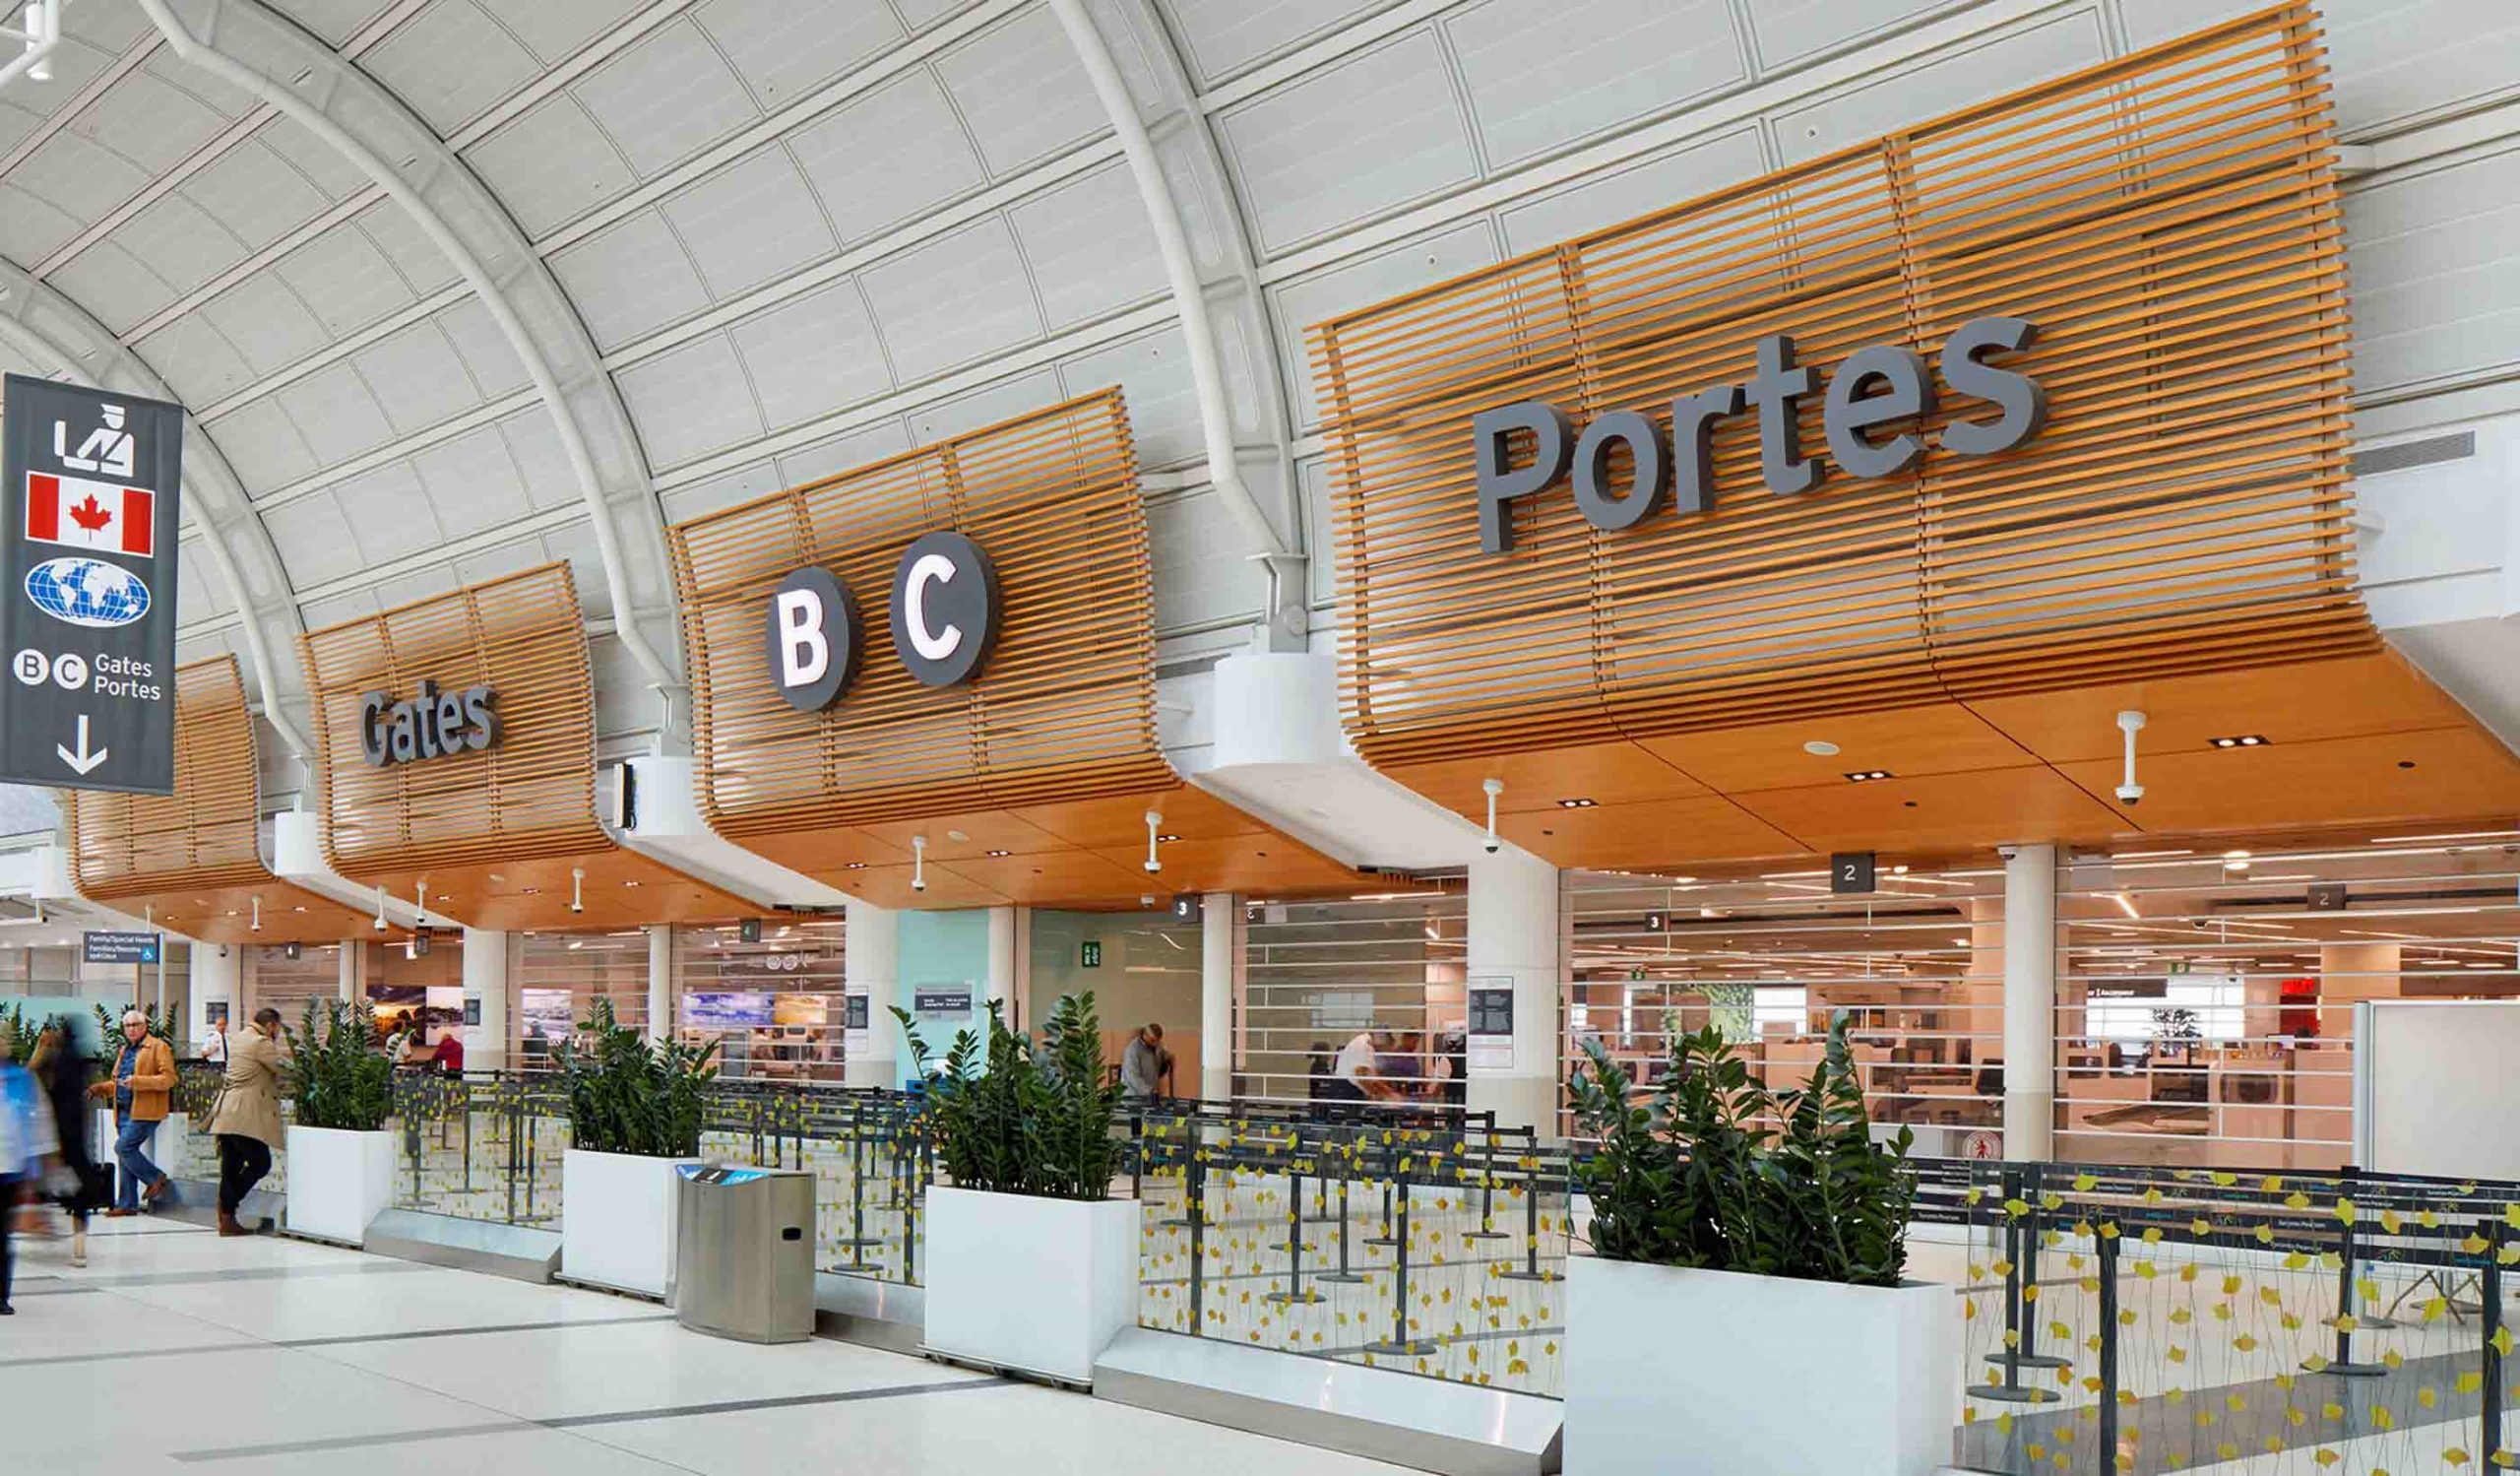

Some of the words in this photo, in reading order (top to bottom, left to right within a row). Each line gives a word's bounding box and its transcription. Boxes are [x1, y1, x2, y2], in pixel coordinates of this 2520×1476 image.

[1473, 316, 2048, 553] Portes
[778, 589, 828, 687] B
[905, 553, 962, 660] C
[23, 655, 40, 677] B
[61, 660, 78, 682] C
[94, 653, 153, 677] Gates
[94, 674, 161, 701] Portes
[360, 679, 502, 767] Gates
[1843, 865, 1856, 881] 2
[1177, 902, 1187, 916] 3
[2318, 892, 2329, 906] 2
[1650, 916, 1660, 929] 3
